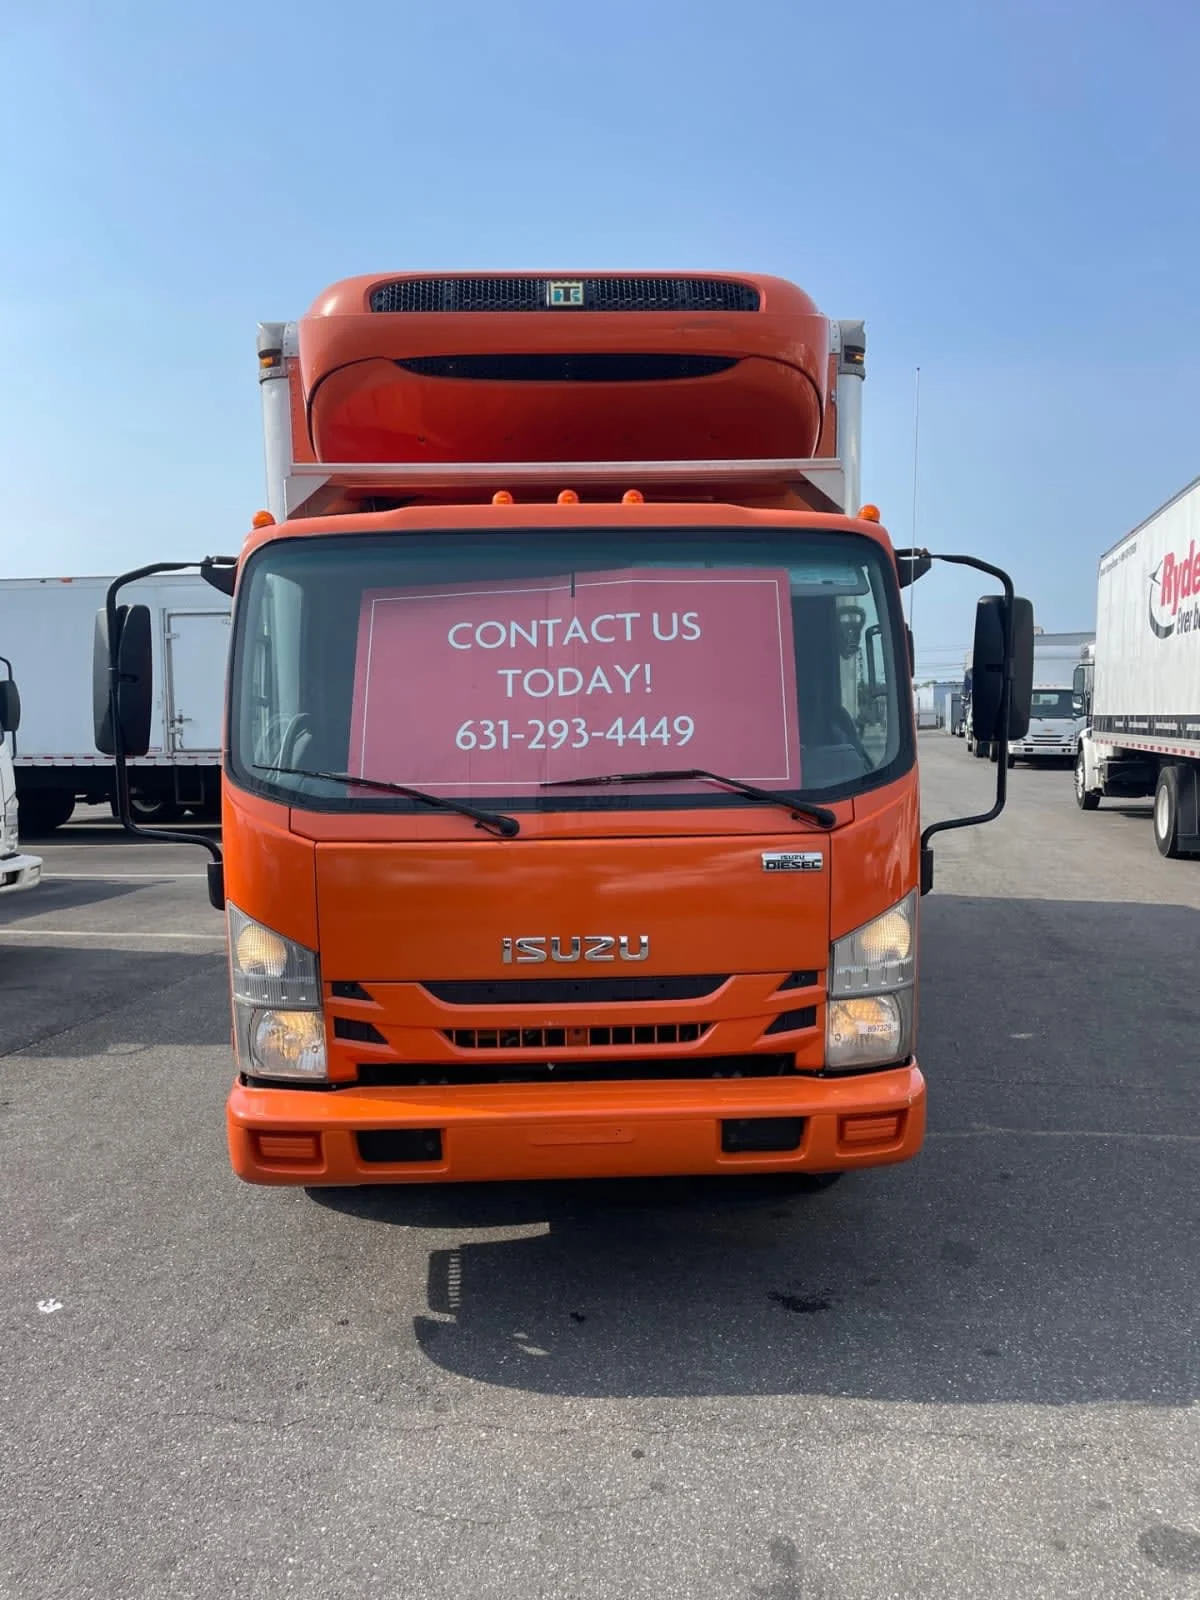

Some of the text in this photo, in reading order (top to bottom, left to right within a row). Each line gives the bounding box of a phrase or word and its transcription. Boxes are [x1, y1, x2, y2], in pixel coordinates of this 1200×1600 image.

[447, 611, 702, 650] CONTACT US
[1176, 606, 1193, 635] Ever
[497, 663, 653, 698] TODAY!
[455, 715, 695, 751] 631-293-4449
[765, 859, 822, 869] DIESEL
[502, 935, 649, 964] ISUZU
